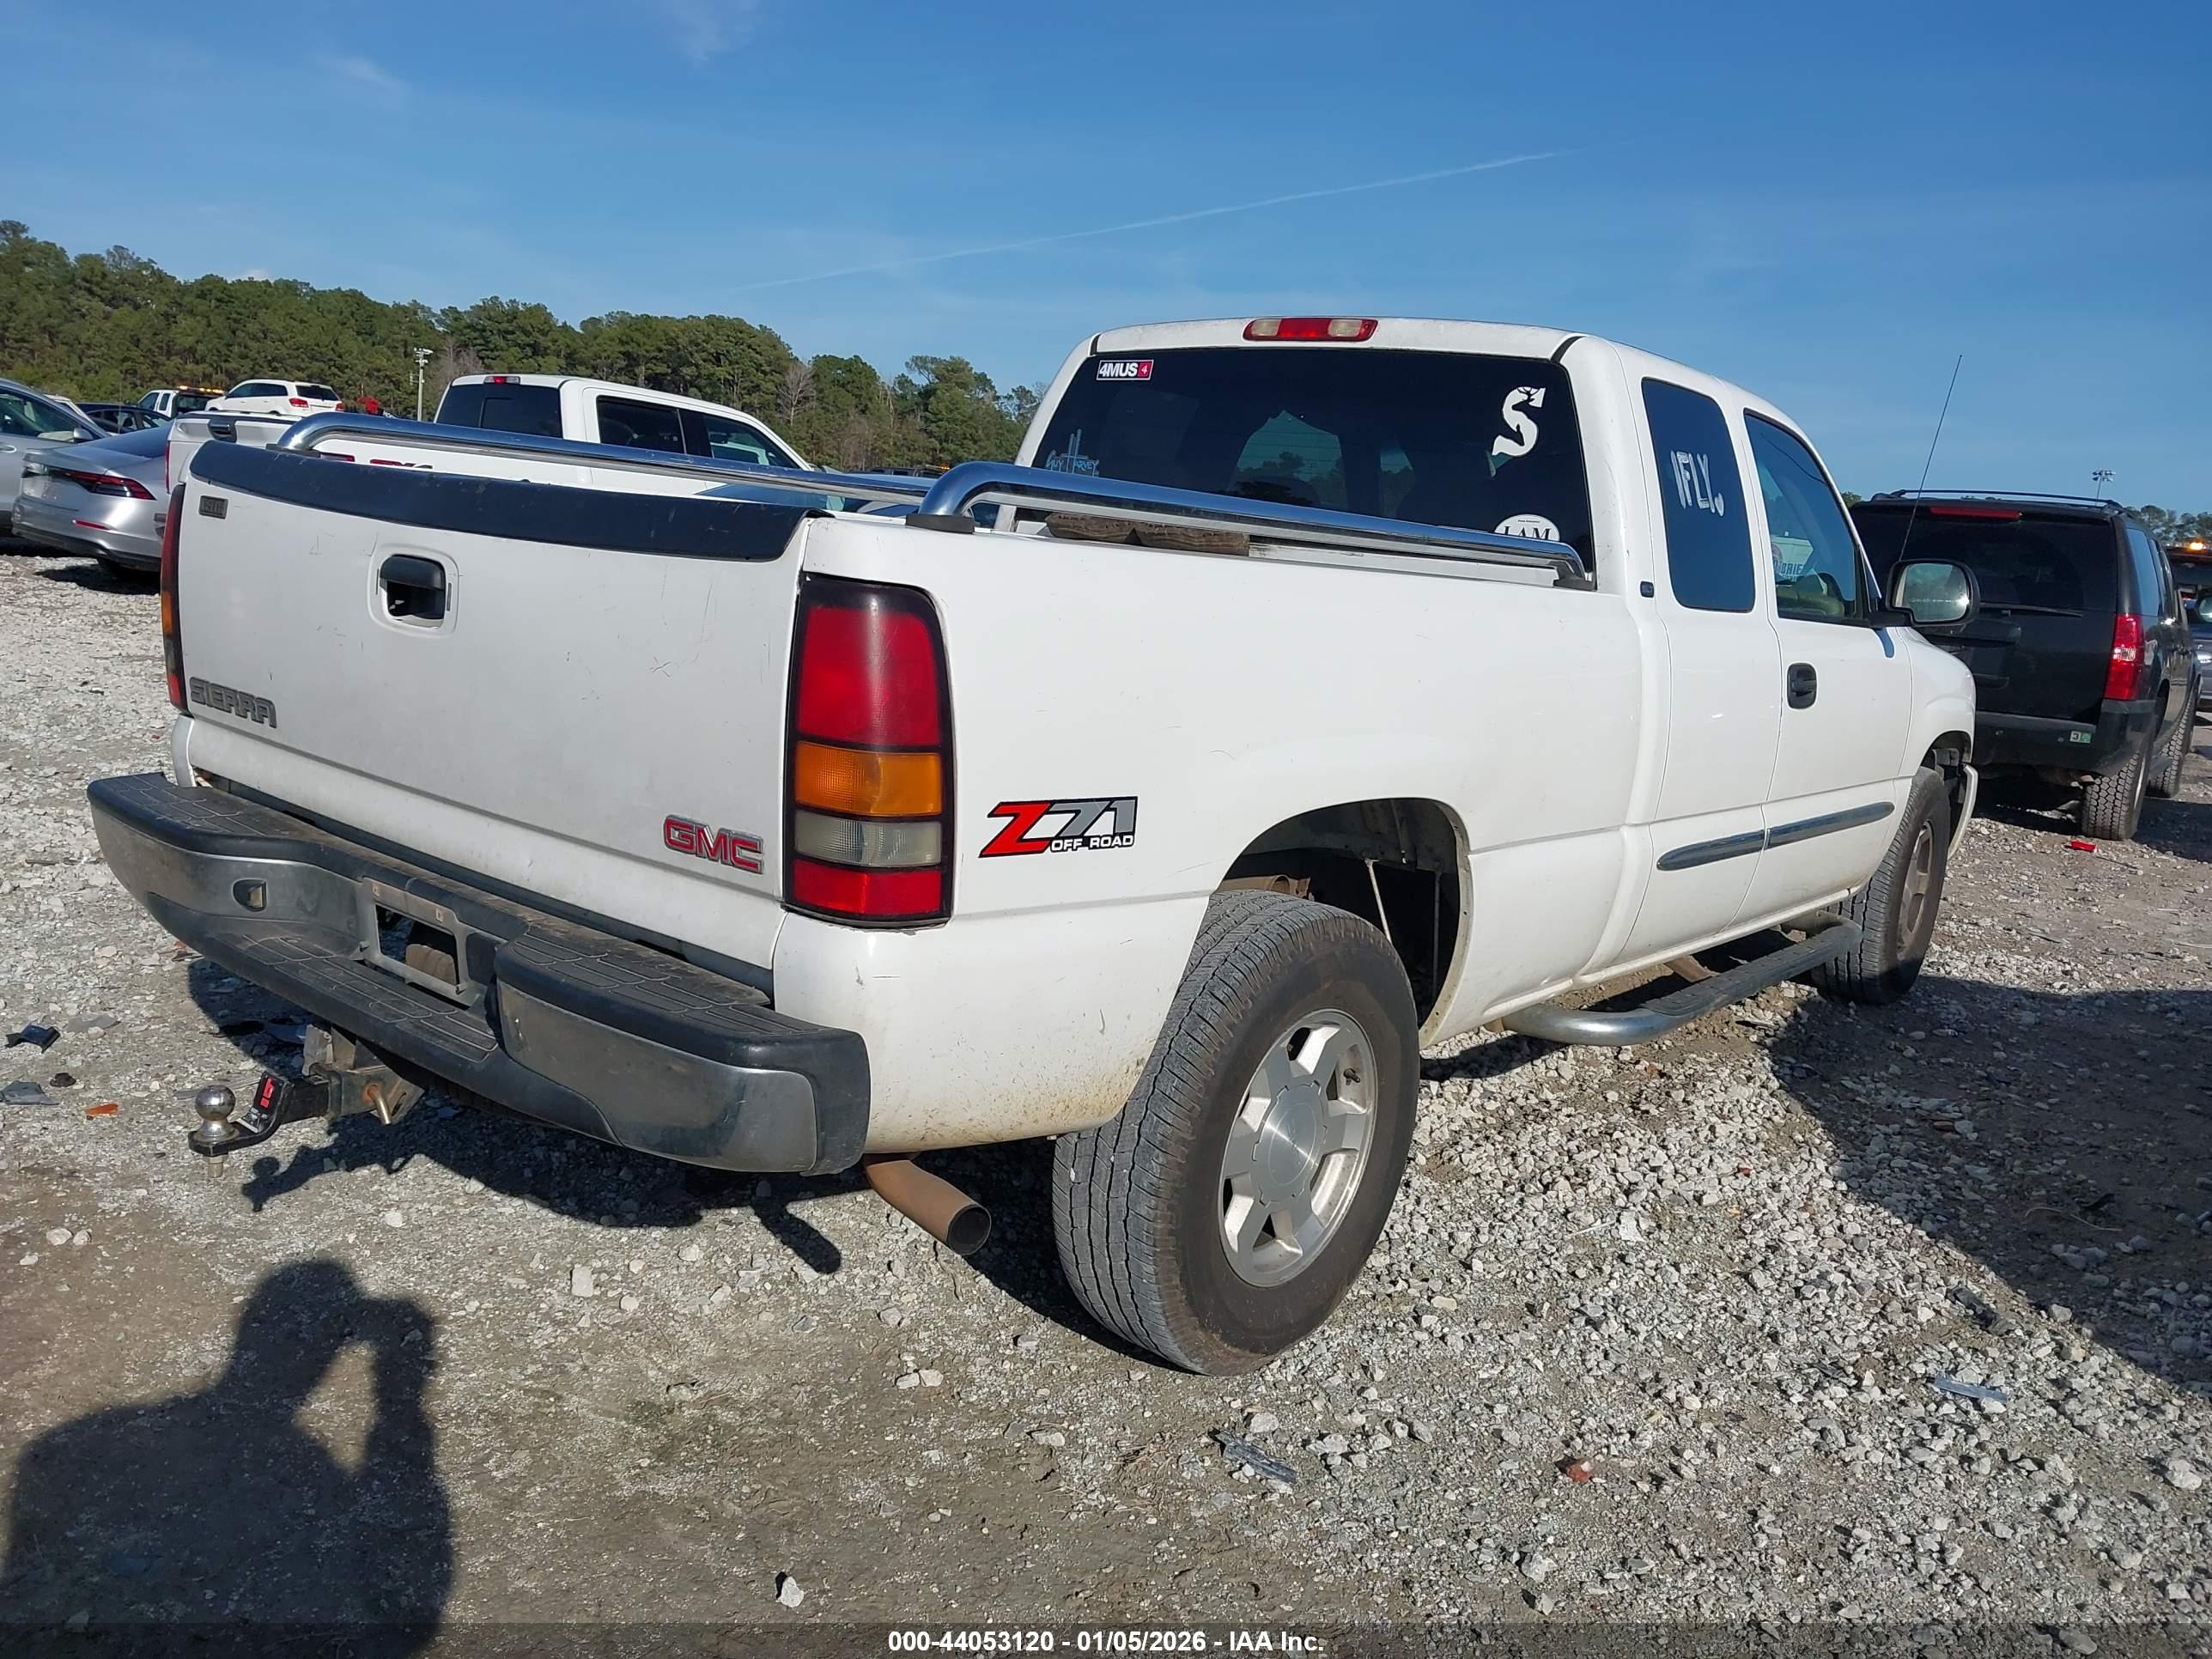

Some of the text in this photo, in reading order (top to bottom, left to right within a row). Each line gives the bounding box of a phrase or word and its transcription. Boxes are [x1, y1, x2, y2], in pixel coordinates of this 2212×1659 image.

[1099, 362, 1149, 378] 4MUS 4
[189, 677, 276, 729] SIERRA
[664, 815, 763, 874] GMC
[978, 796, 1138, 858] Z71
[1051, 835, 1133, 852] OFF ROAD
